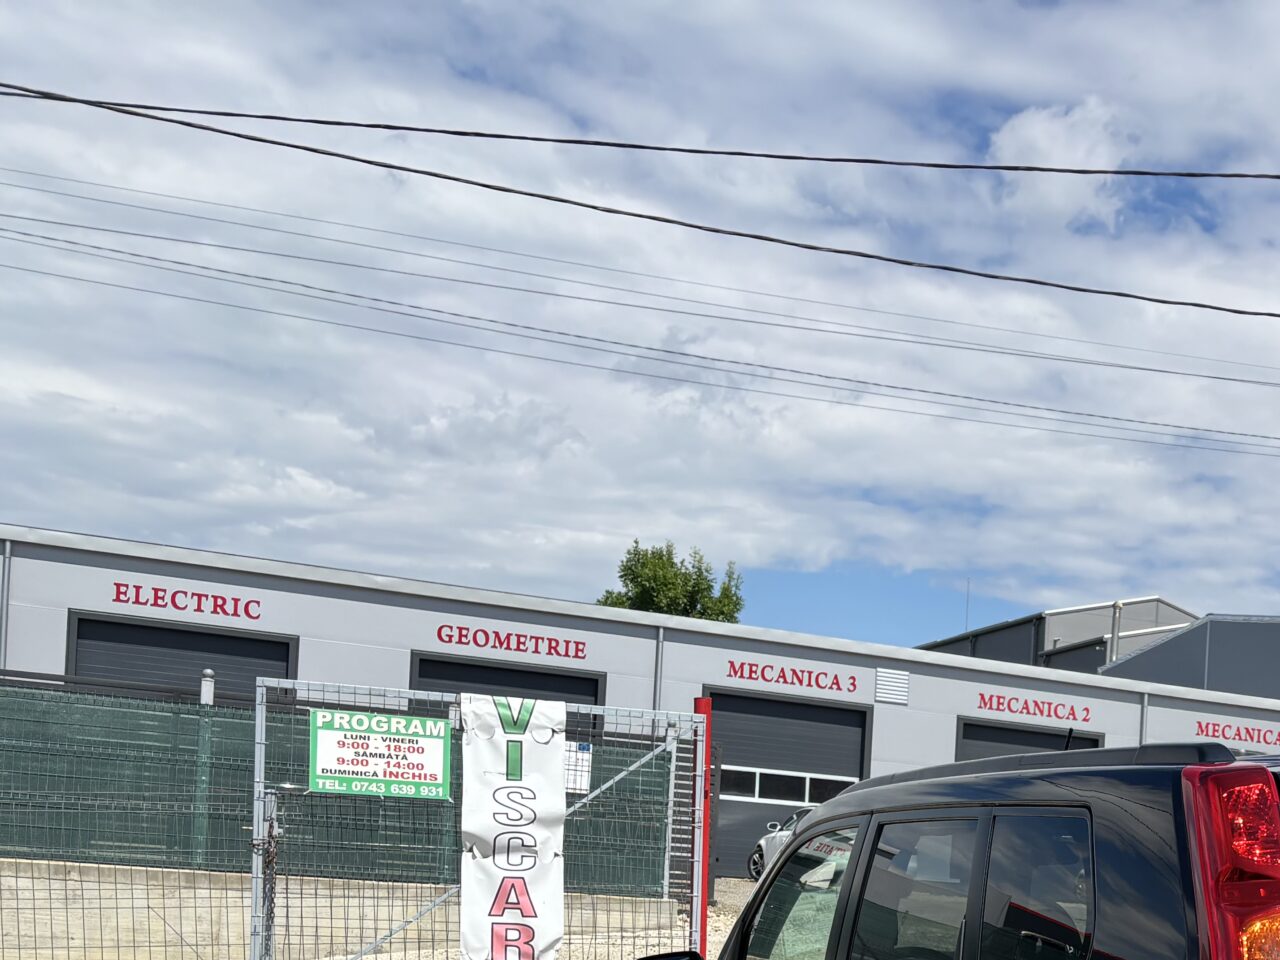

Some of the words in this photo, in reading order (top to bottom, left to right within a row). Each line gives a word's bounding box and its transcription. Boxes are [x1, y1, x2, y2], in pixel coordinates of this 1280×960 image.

[112, 582, 261, 620] ELECTRIC
[436, 624, 587, 660] GEOMETRIE
[726, 660, 842, 691] MECANICA
[847, 675, 857, 693] 3
[977, 693, 1078, 721] MECANICA
[1081, 707, 1091, 722] 2
[316, 711, 445, 737] PROGRAM
[336, 740, 370, 750] 9:00
[384, 744, 425, 754] 18:00
[344, 733, 371, 742] LUNI
[381, 736, 419, 745] VINERI
[336, 757, 369, 767] 9:00
[384, 761, 424, 771] 14:00
[382, 768, 438, 781] ÎNCHIS
[316, 779, 347, 790] TEL:
[352, 781, 386, 793] 0743
[390, 784, 416, 795] 639
[420, 786, 443, 797] 931
